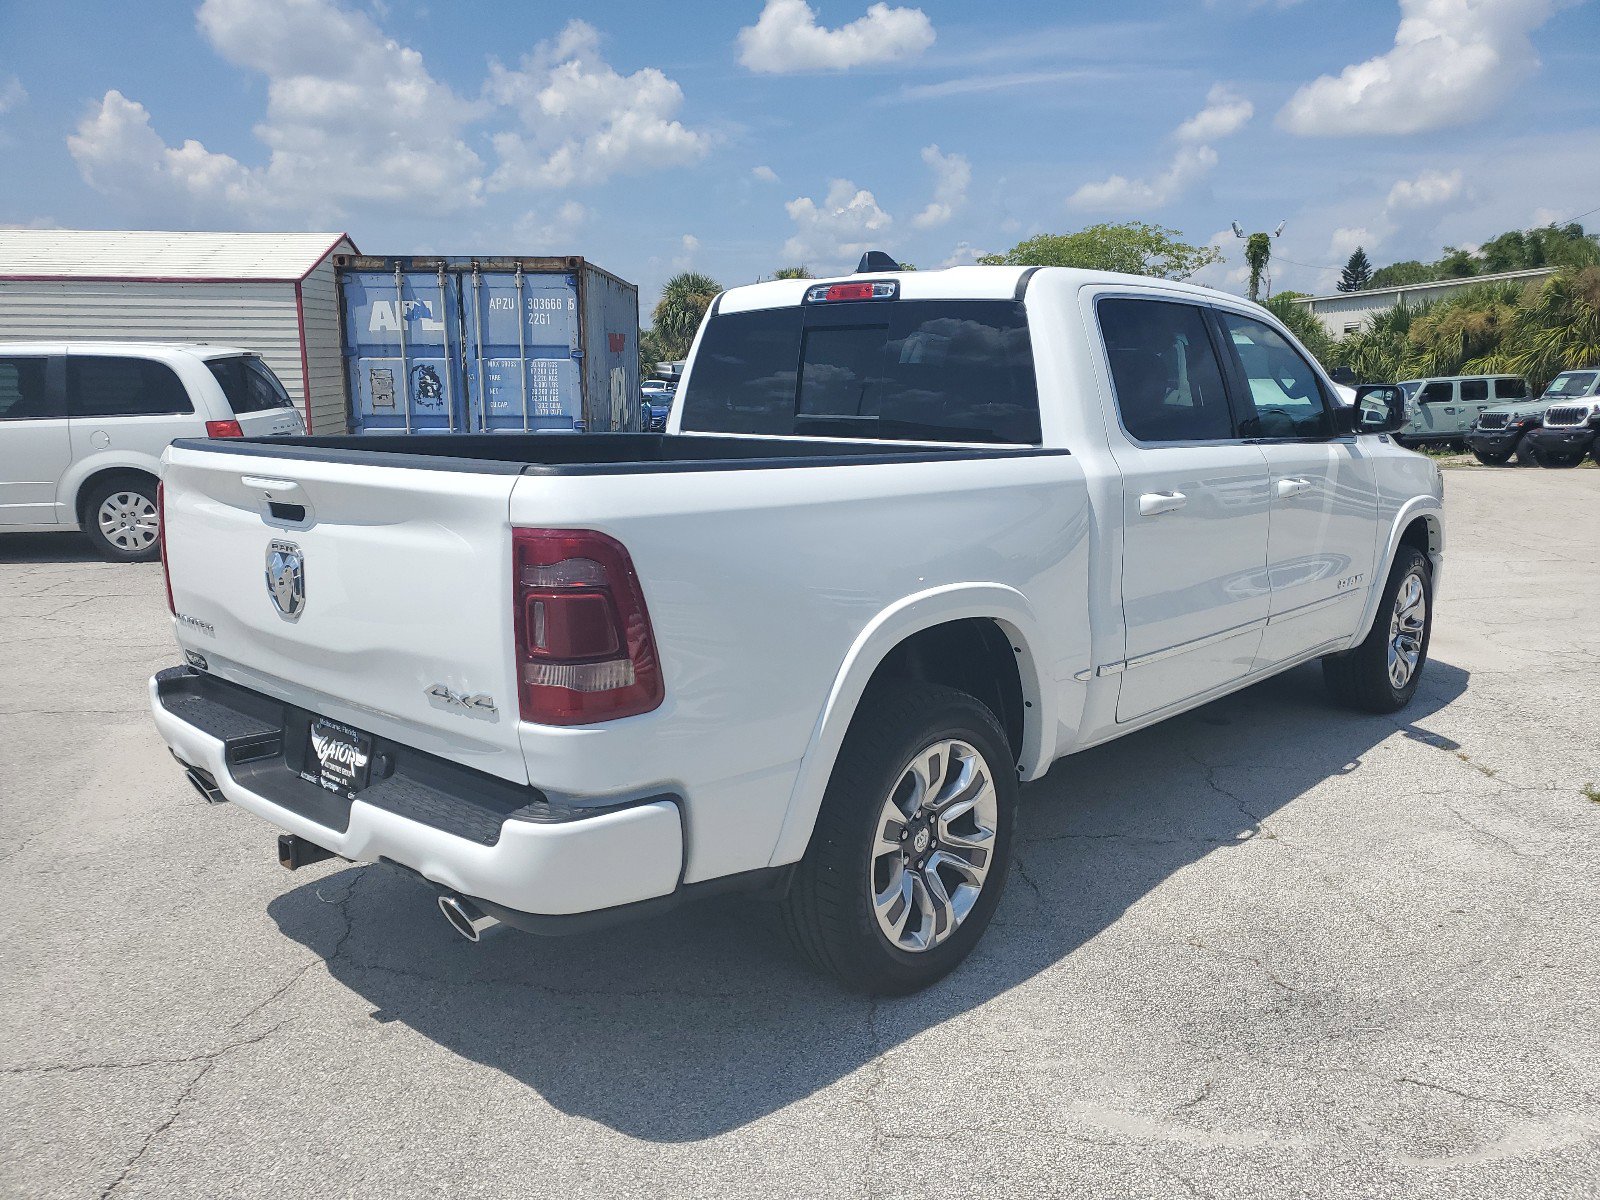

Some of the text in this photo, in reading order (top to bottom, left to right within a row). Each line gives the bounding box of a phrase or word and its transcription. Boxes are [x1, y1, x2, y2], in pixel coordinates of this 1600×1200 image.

[489, 298, 514, 310] APZU
[527, 298, 562, 310] 303666
[528, 313, 550, 325] 22G1
[271, 543, 294, 552] RAM
[317, 736, 357, 777] GATOR
